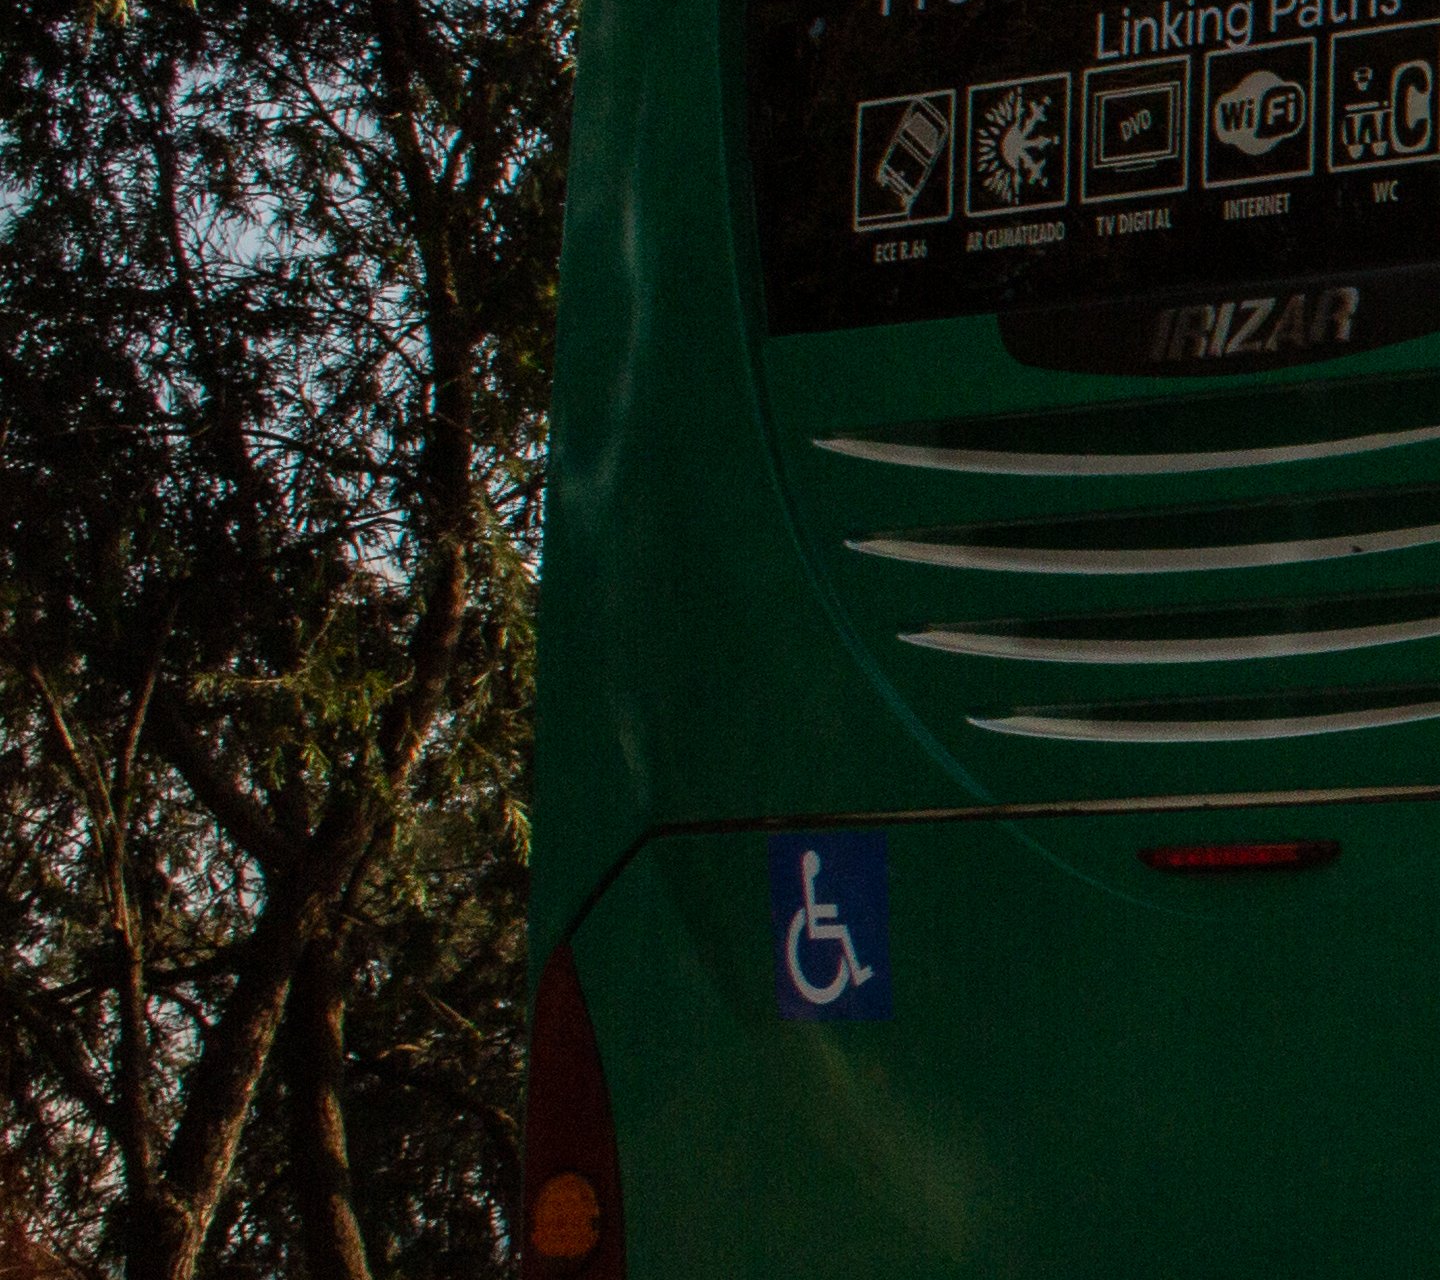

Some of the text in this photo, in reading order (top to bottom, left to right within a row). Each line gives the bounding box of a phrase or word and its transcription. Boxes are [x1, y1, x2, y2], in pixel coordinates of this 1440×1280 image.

[1119, 109, 1153, 142] DVD
[1223, 192, 1291, 221] INTERNET
[1372, 179, 1399, 204] WC
[966, 221, 1067, 252] AR CLIMATIZADO
[1096, 207, 1173, 236] TV DIGITAL
[1150, 285, 1360, 363] IRIZAR
